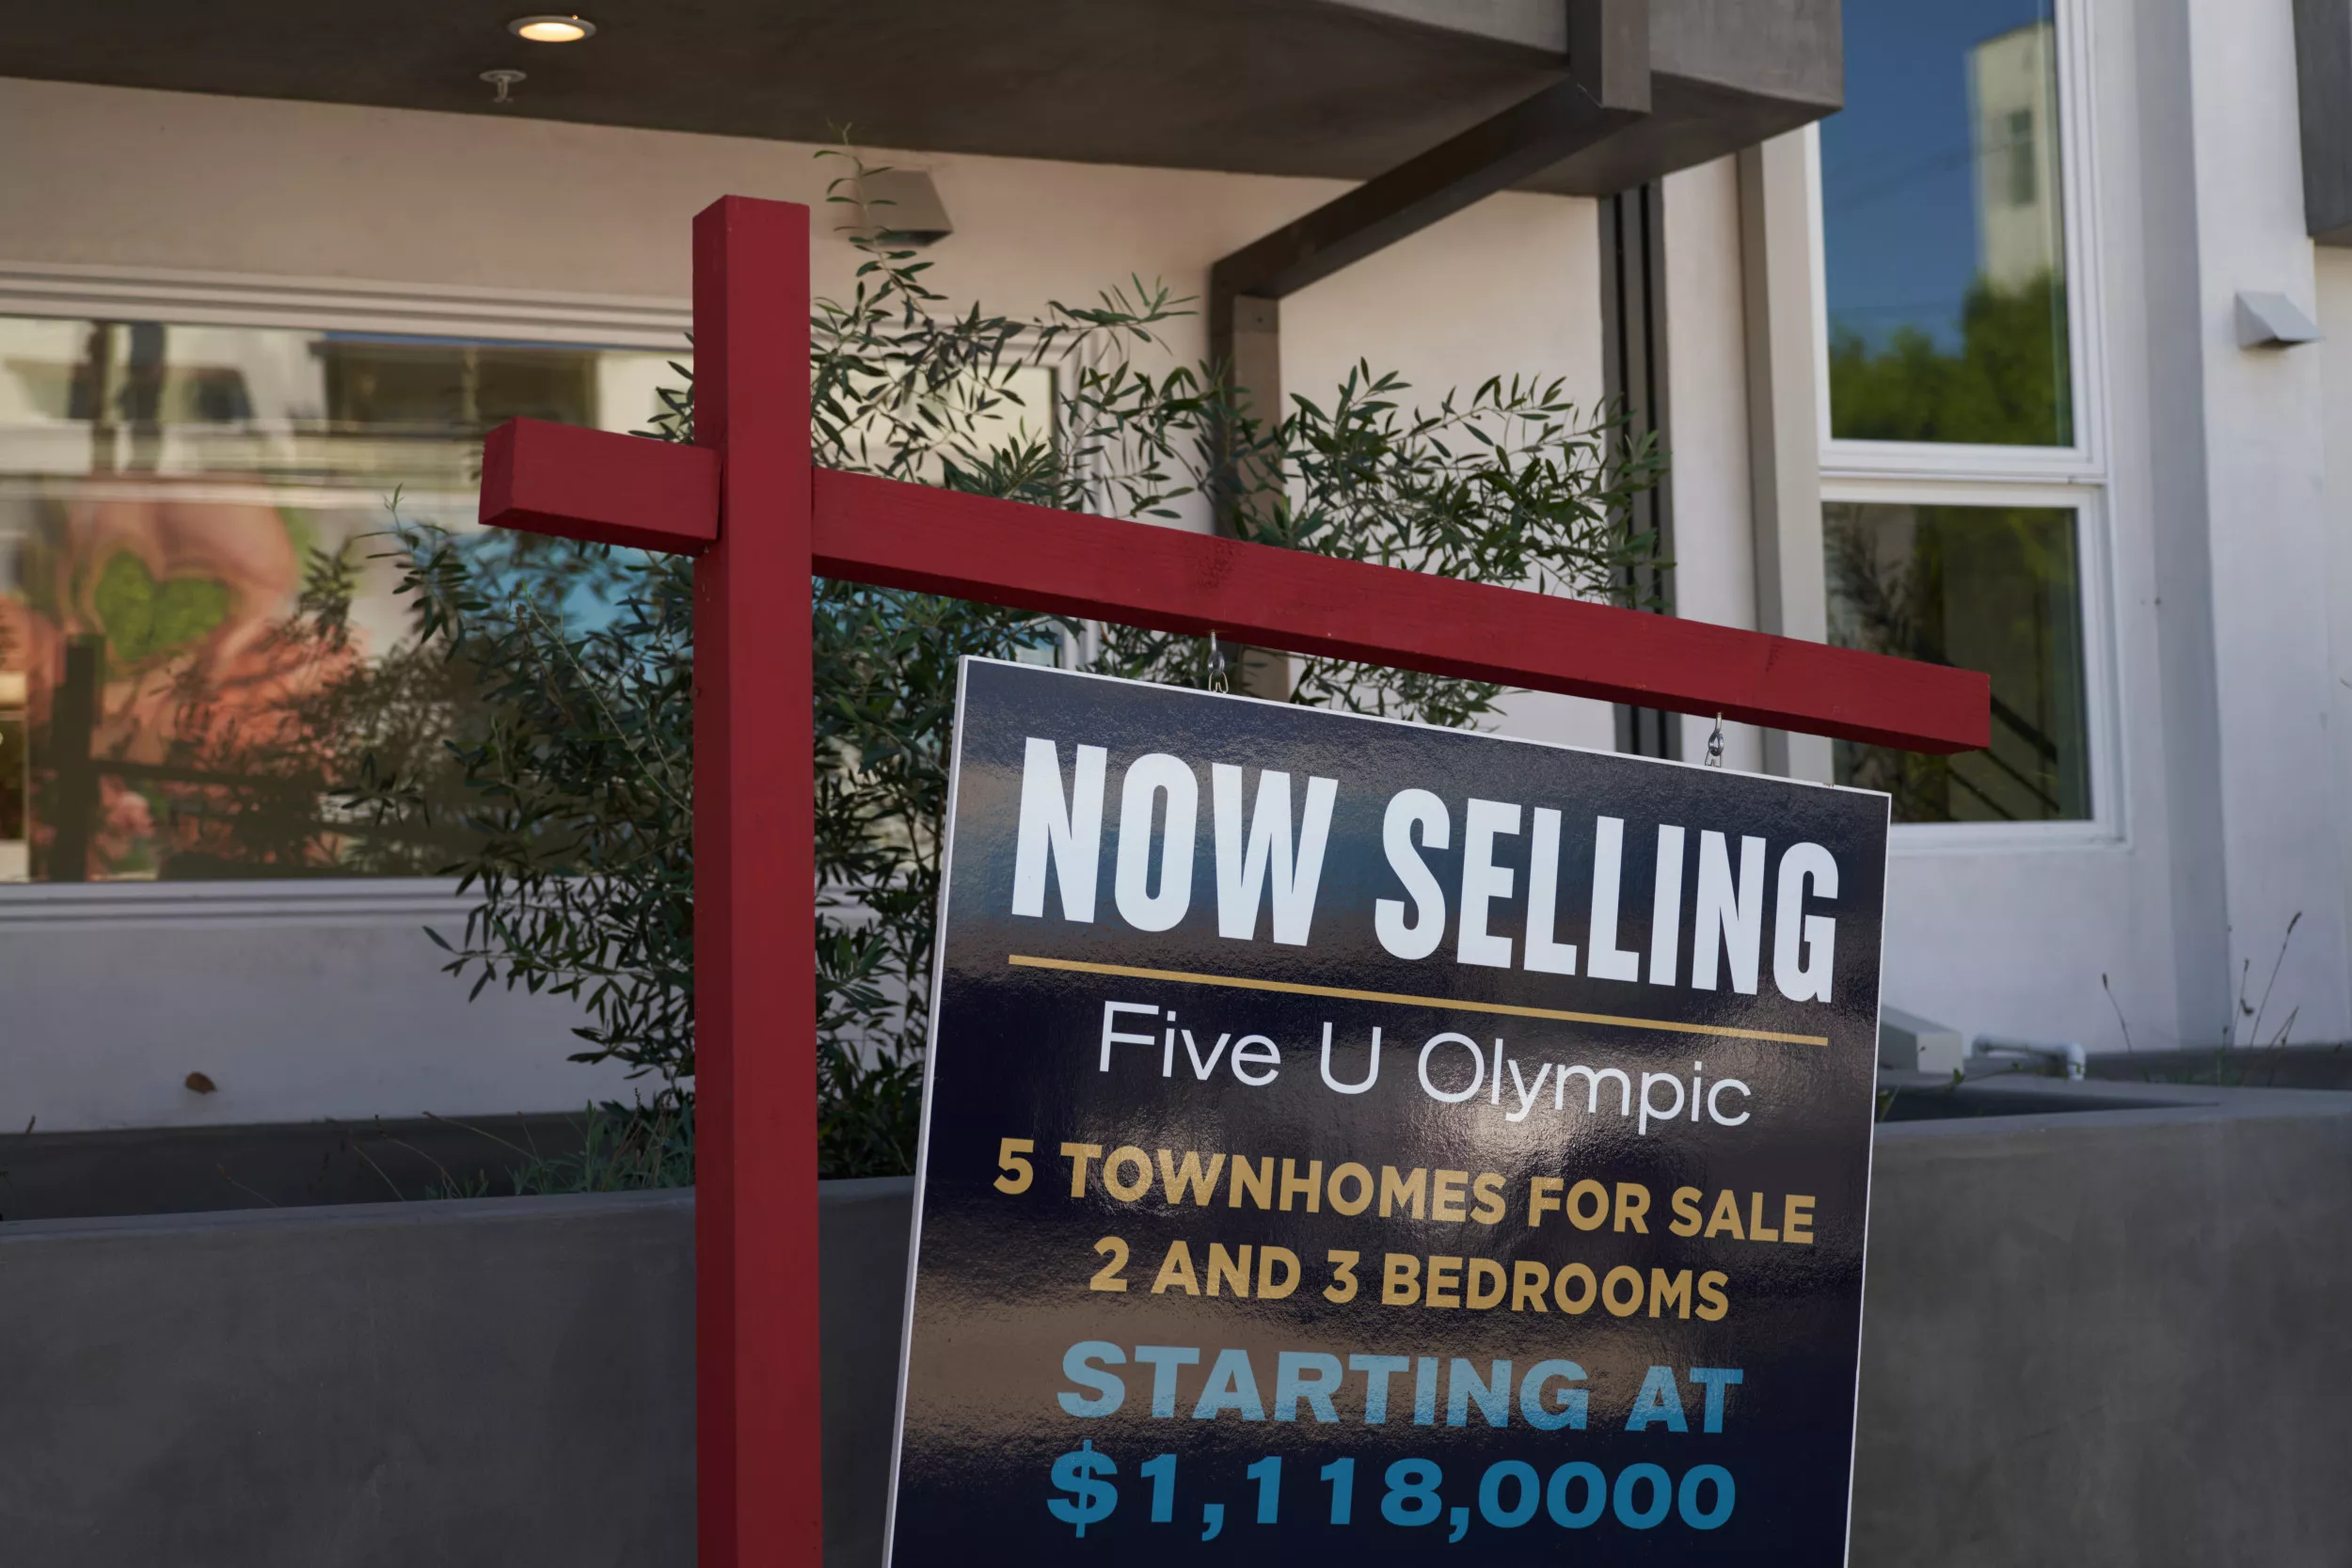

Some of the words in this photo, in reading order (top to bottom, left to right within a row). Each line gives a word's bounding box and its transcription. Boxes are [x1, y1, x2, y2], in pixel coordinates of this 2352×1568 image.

[1011, 736, 1338, 946] NOW
[1374, 788, 1839, 1003] SELLING
[1099, 1001, 1280, 1086] Five
[1320, 1021, 1382, 1094] U
[1417, 1031, 1752, 1135] Olympic
[993, 1138, 1035, 1195] 5
[1060, 1142, 1506, 1225] TOWNHOMES
[1528, 1176, 1652, 1234] FOR
[1668, 1185, 1817, 1244] SALE
[1089, 1237, 1129, 1292] 2
[1152, 1241, 1301, 1301] AND
[1323, 1249, 1360, 1304] 3
[1382, 1252, 1730, 1321] BEDROOMS
[1057, 1340, 1590, 1430] STARTING
[1625, 1364, 1743, 1433] AT
[1046, 1439, 1737, 1542] $1,118,0000
